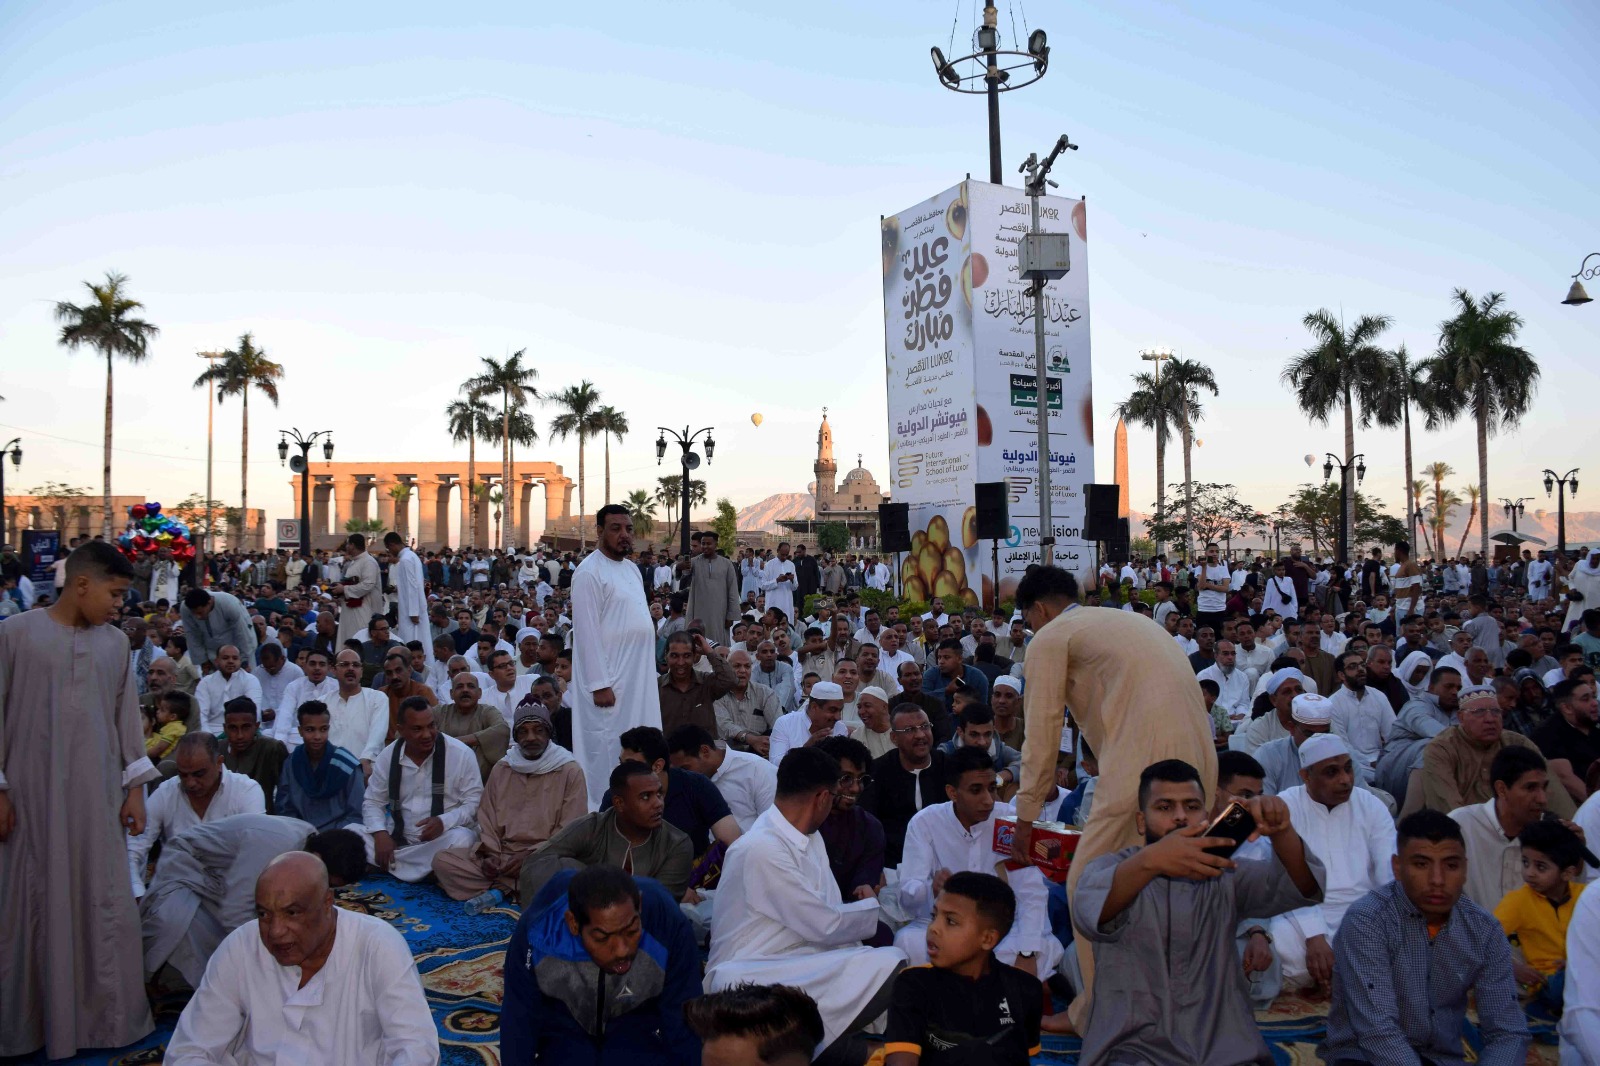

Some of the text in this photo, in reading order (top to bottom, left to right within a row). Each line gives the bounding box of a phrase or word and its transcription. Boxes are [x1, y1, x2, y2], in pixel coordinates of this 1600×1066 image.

[999, 203, 1030, 216] الأقصر
[999, 349, 1024, 358] المقدسة
[1012, 378, 1033, 388] سياحة
[896, 407, 968, 438] فيوتشر الدولية
[925, 451, 944, 460] Future
[925, 455, 962, 468] International
[1003, 449, 1037, 464] الدولية
[925, 466, 945, 477] School
